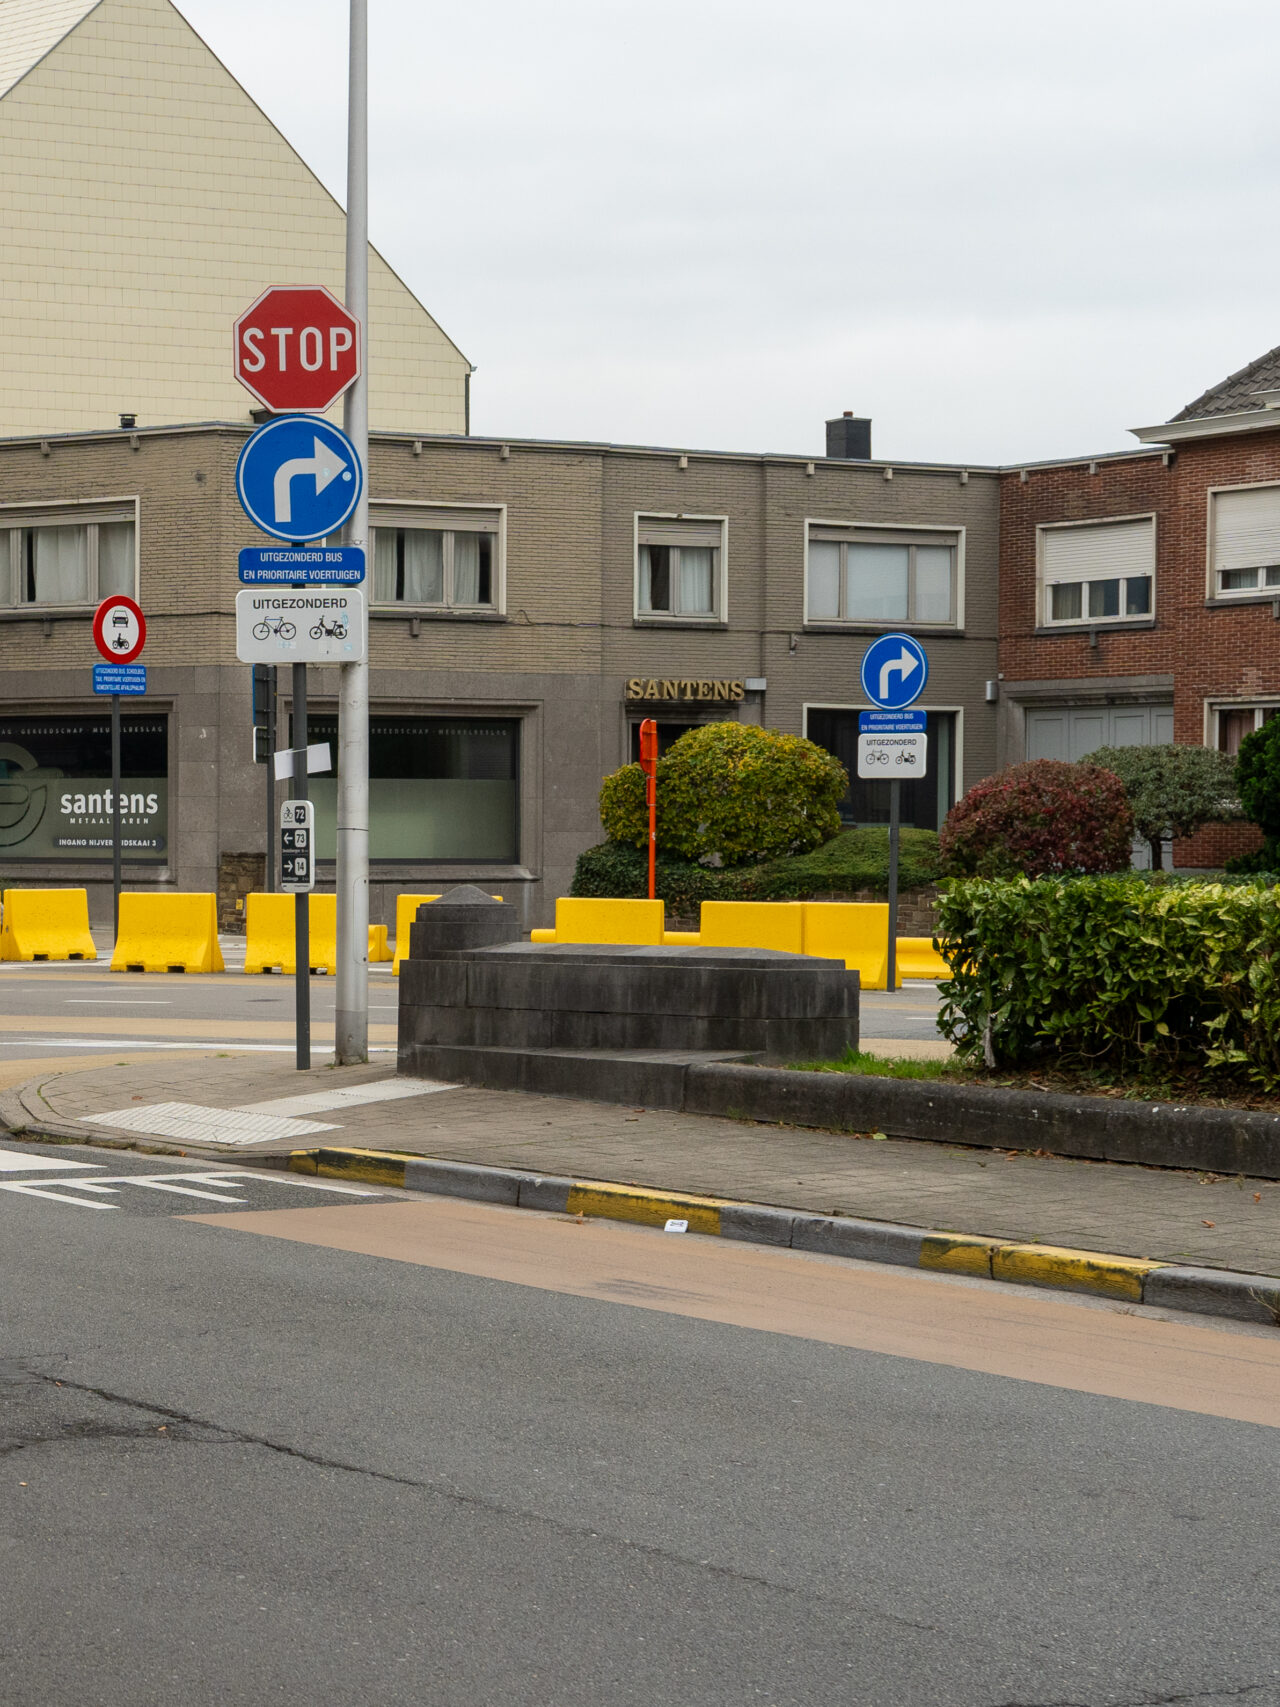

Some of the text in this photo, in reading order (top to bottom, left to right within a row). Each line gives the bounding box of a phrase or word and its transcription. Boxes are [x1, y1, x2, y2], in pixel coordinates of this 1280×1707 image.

[242, 326, 353, 373] STOP
[260, 552, 342, 562] UITGEZONDERD BUS
[244, 570, 360, 580] EN PRIORITAIRE VOERTUIGEN
[252, 598, 348, 609] UITGEZONDERD
[626, 678, 745, 700] SANTENS
[60, 789, 158, 814] santens
[295, 809, 305, 820] 72
[296, 833, 305, 843] 73
[297, 862, 304, 871] 14
